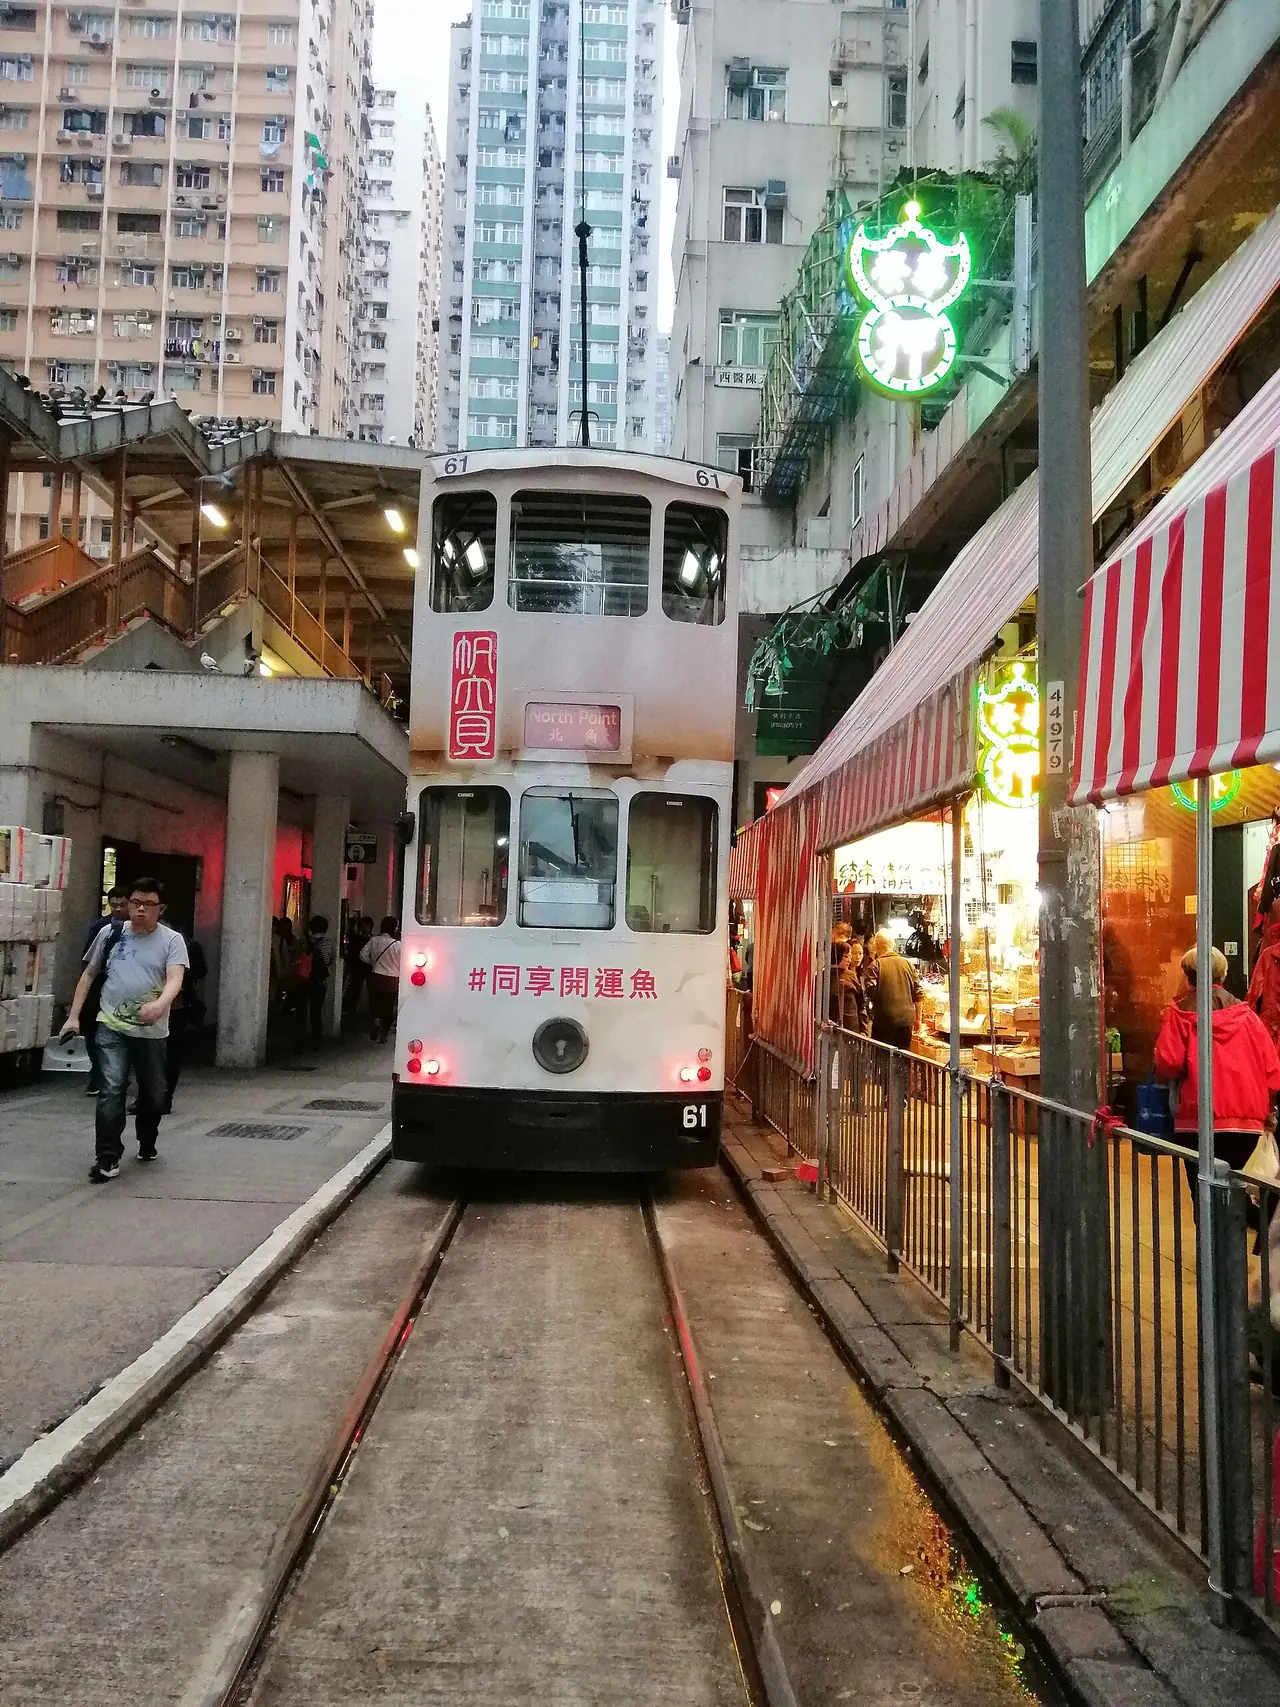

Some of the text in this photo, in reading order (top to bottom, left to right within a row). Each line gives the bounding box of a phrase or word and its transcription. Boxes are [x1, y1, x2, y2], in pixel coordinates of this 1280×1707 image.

[444, 455, 469, 475] 61
[696, 469, 720, 489] 61
[529, 710, 618, 726] North Point
[548, 729, 598, 743] 北角
[1049, 689, 1063, 769] 44979
[468, 964, 659, 1000] #同享開運魚
[682, 1104, 707, 1128] 61
